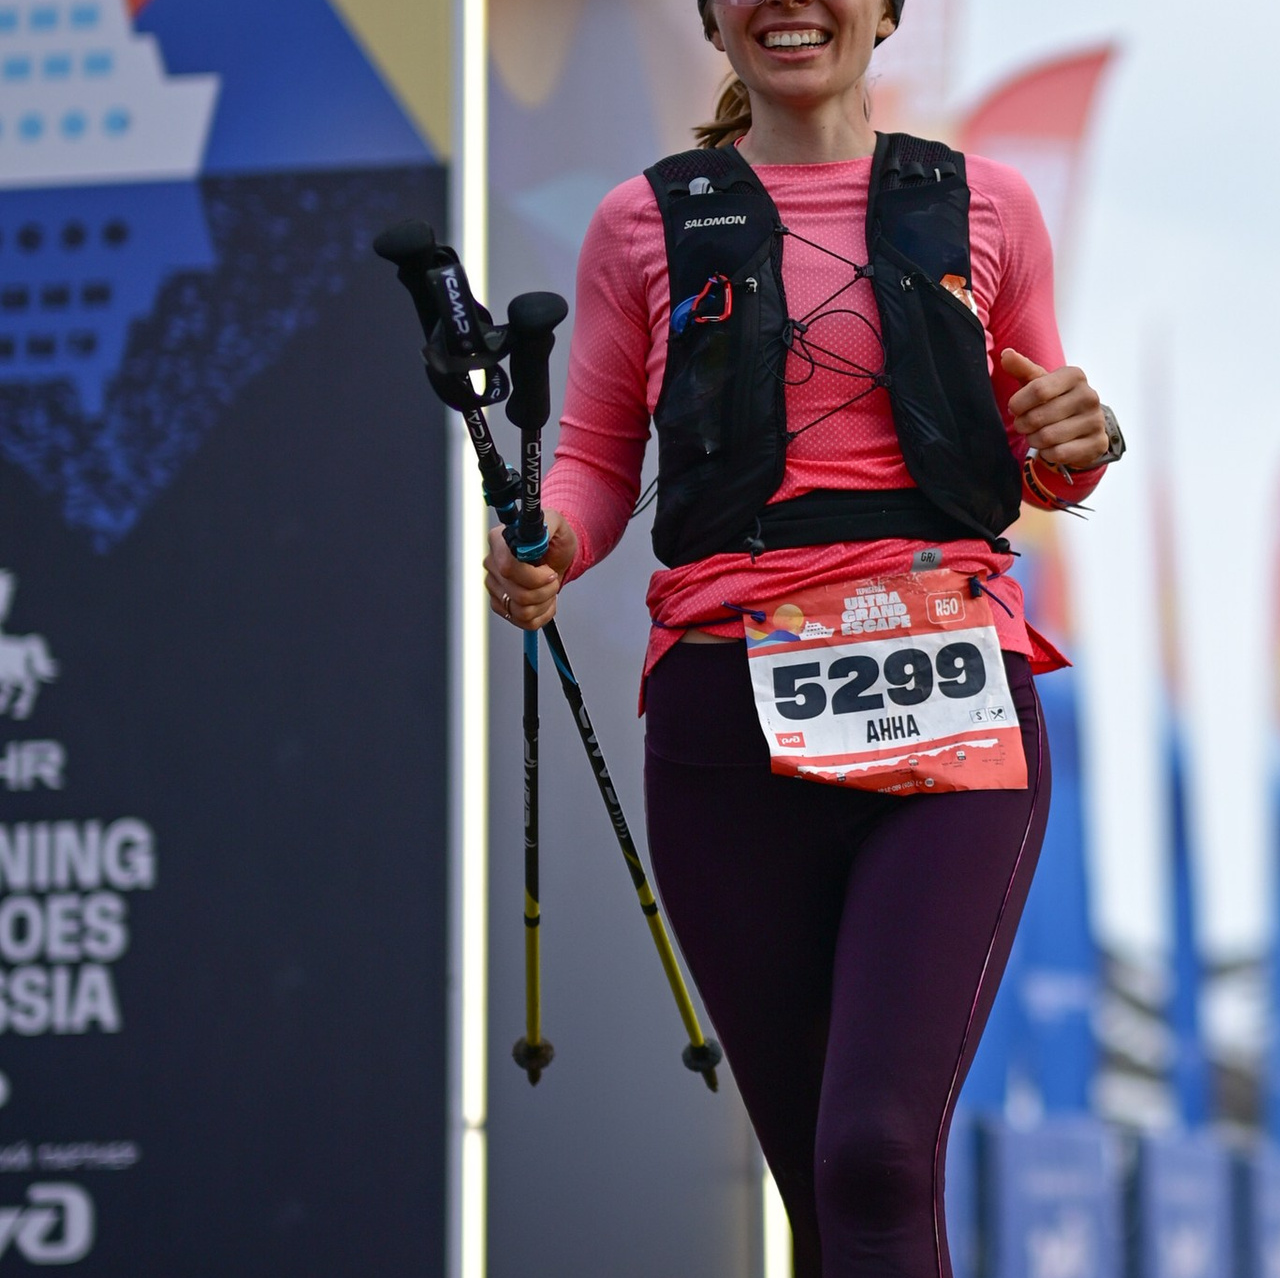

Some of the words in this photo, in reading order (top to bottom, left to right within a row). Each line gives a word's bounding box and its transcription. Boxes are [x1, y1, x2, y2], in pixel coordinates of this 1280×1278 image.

[684, 215, 747, 230] SALOMON
[445, 274, 470, 335] CAMP
[526, 442, 541, 496] CAMP
[841, 603, 907, 623] GRAND
[844, 591, 902, 610] ULTRA
[934, 597, 959, 617] R50
[841, 614, 912, 636] ESCAPE
[772, 642, 987, 720] 5299
[866, 714, 921, 743] АННА
[0, 817, 156, 890] NING
[0, 891, 128, 963] OES
[0, 965, 121, 1036] SIA
